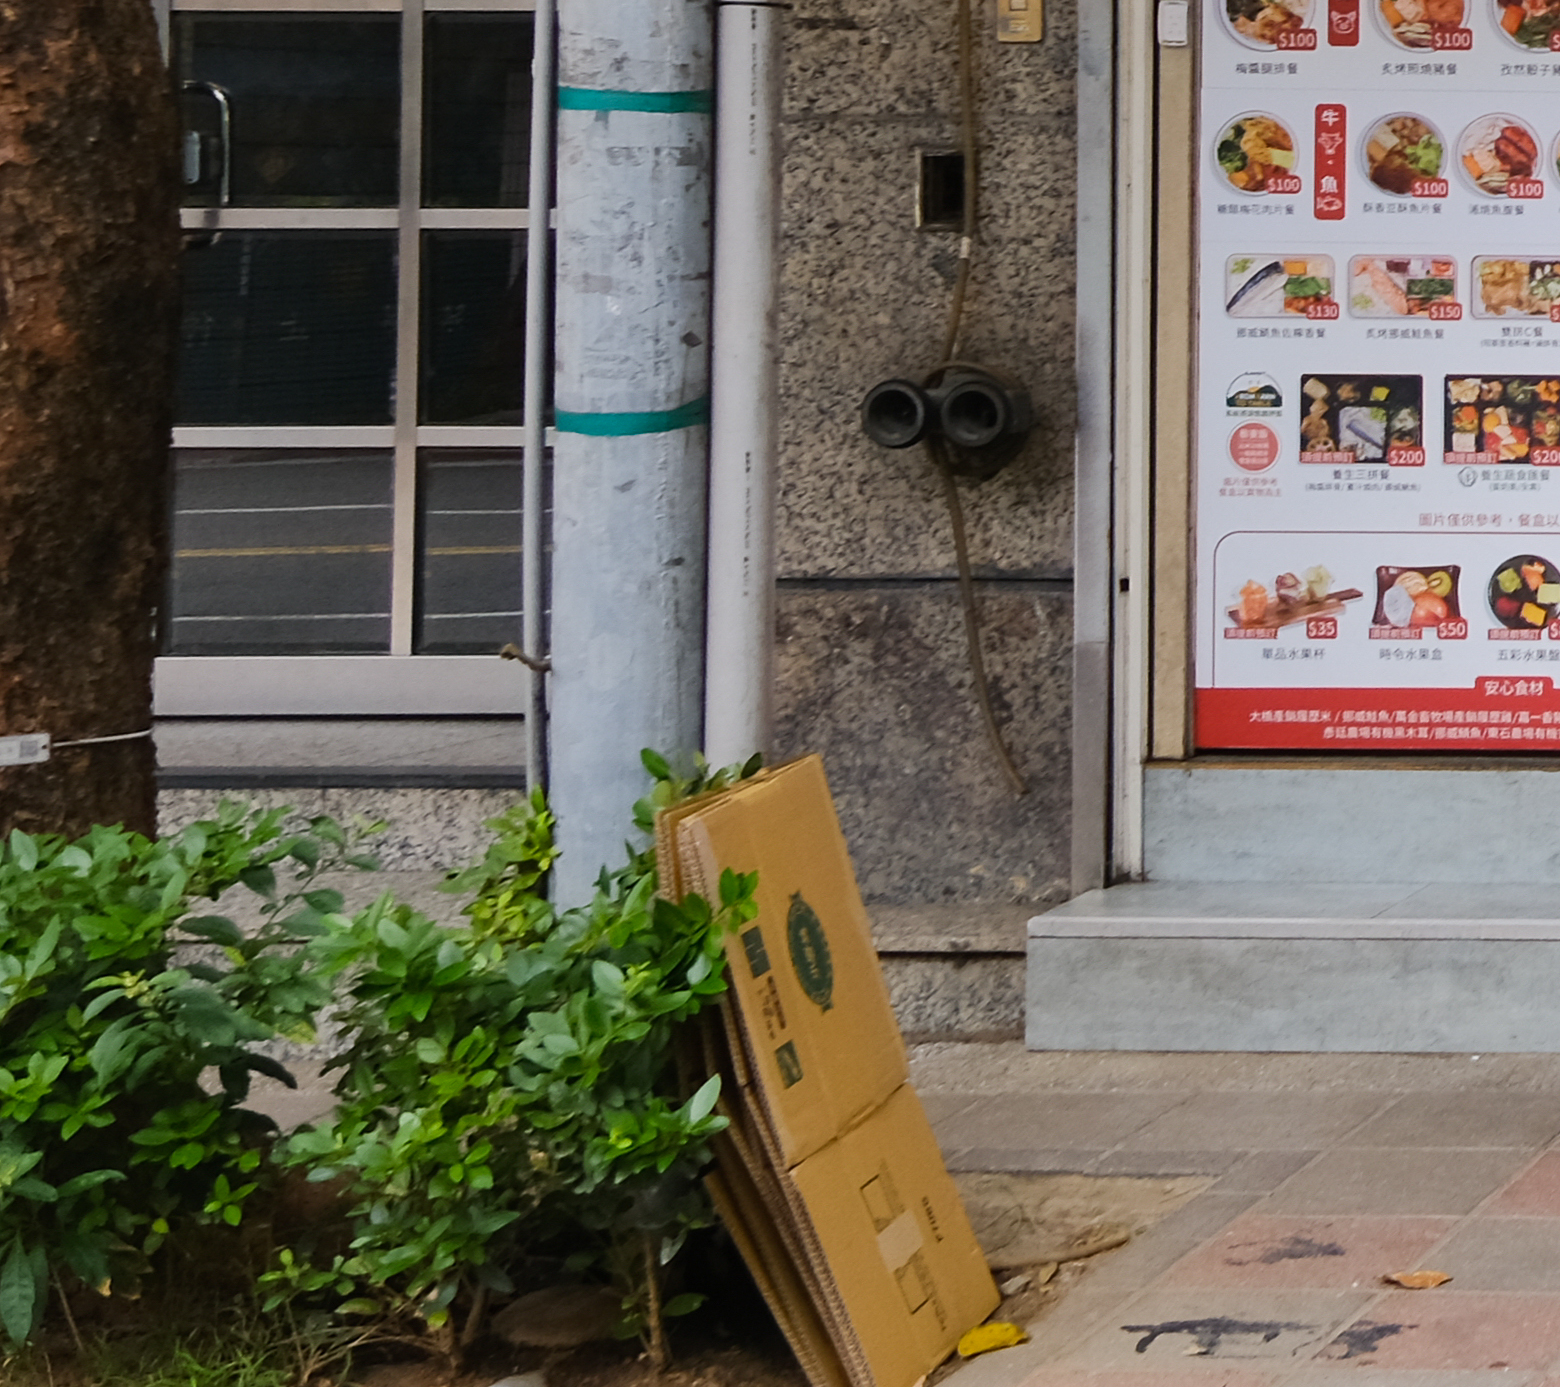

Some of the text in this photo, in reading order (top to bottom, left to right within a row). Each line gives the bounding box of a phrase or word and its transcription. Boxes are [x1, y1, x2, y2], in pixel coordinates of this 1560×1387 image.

[1278, 31, 1316, 48] $100
[1433, 31, 1471, 48] $100
[1320, 109, 1340, 126] 牛
[1266, 178, 1300, 192] $100
[1320, 175, 1340, 194] 魚
[1412, 180, 1448, 196] $100
[1507, 181, 1543, 197] $100
[1306, 304, 1338, 318] $130
[1429, 305, 1461, 319] $150
[1389, 449, 1423, 465] $200
[1307, 619, 1337, 637] $35
[1438, 620, 1467, 637] $50
[1484, 679, 1545, 697] 安心食材
